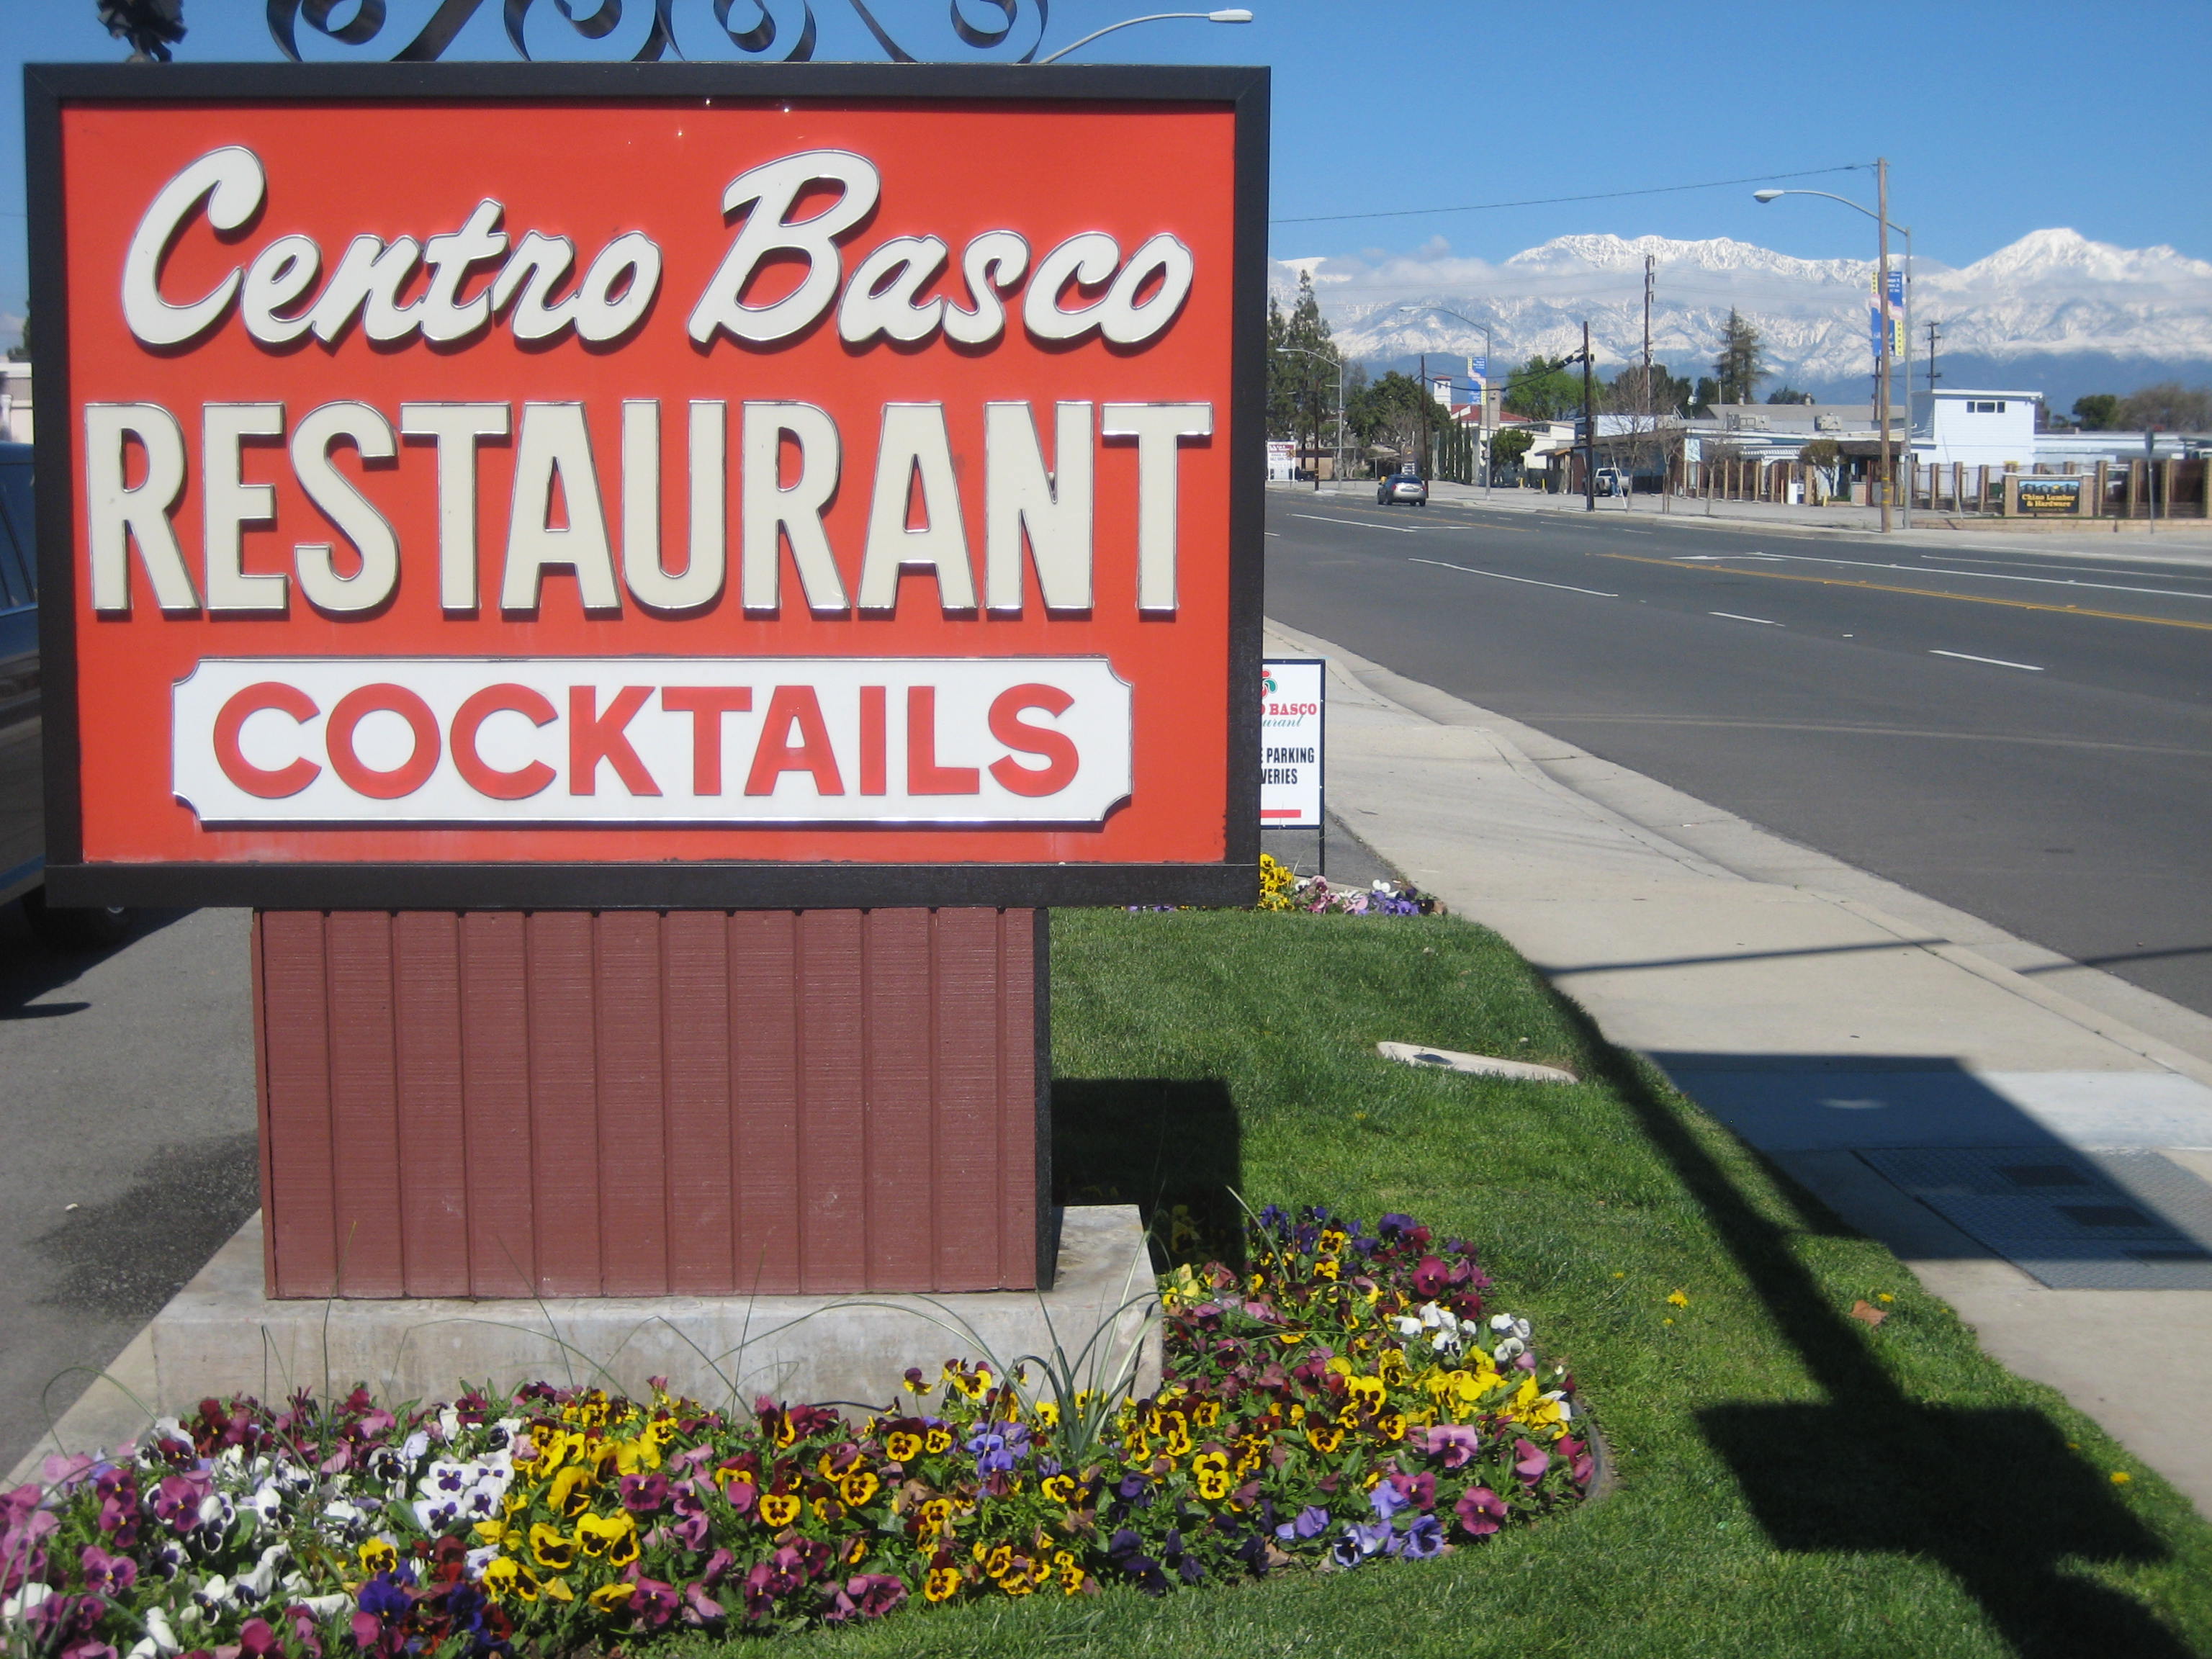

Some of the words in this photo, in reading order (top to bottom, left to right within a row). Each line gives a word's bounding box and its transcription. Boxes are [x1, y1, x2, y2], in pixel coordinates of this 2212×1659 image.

[120, 145, 662, 346] Centro
[686, 148, 1195, 345] Basco
[84, 400, 1215, 612] RESTAURANT
[213, 682, 1080, 799] COCKTAILS
[1267, 747, 1315, 763] PARKING
[1269, 703, 1317, 715] BASCO
